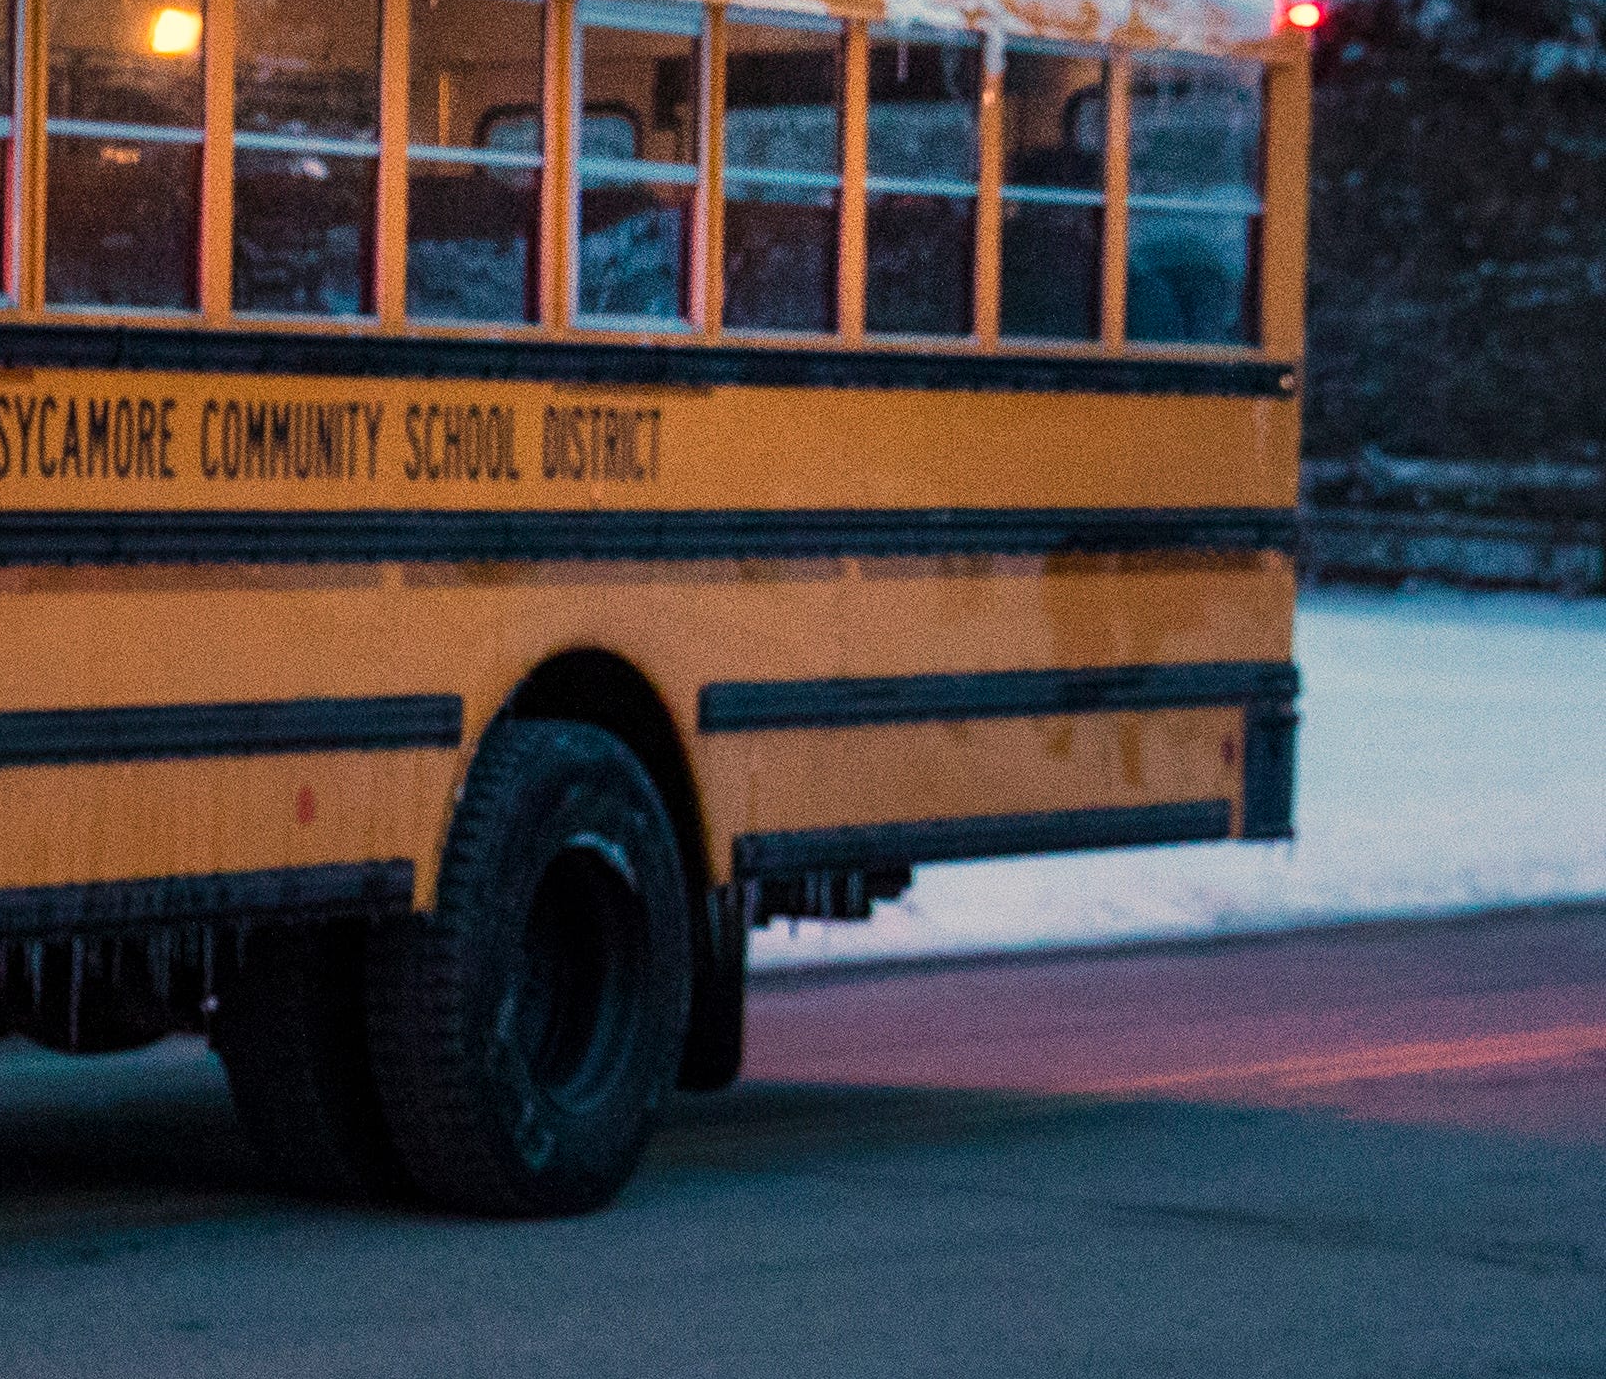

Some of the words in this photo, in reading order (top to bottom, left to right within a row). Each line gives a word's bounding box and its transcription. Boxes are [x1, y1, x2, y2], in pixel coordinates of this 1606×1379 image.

[198, 397, 381, 482] COMMUNITY
[402, 401, 521, 482] SCHOOL
[540, 406, 662, 483] DISTRICT
